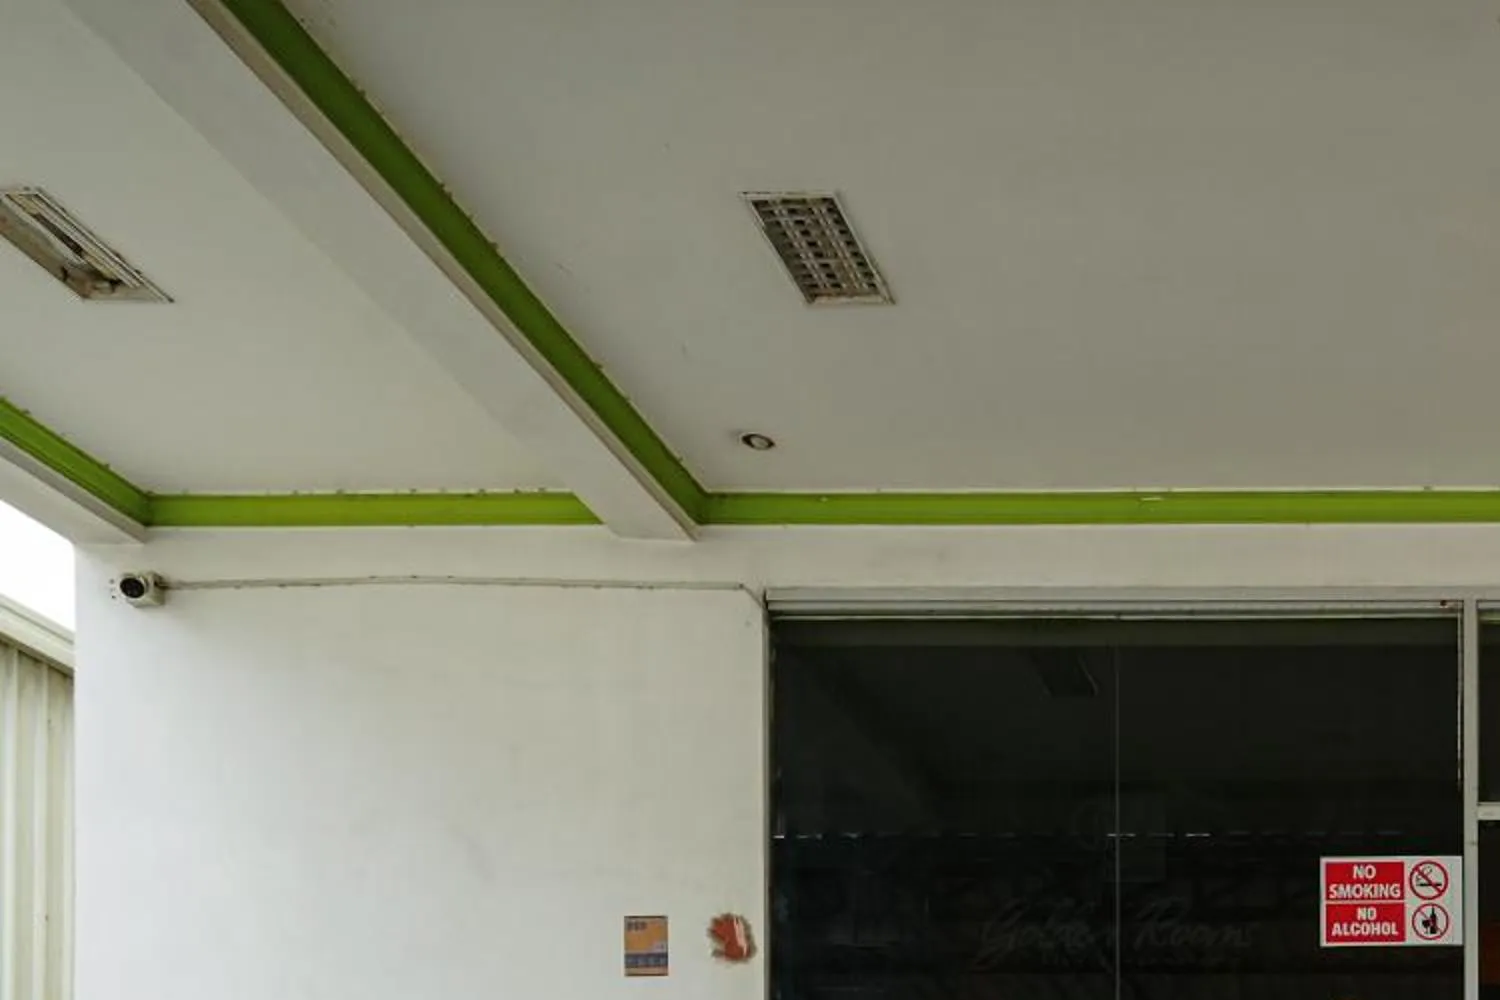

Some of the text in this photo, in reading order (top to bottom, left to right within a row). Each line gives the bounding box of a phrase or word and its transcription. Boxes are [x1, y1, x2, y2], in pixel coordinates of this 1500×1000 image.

[1352, 865, 1376, 879] NO
[1328, 884, 1400, 899] SMOKING
[1356, 907, 1377, 919] NO
[1331, 922, 1399, 936] ALCOHOL
